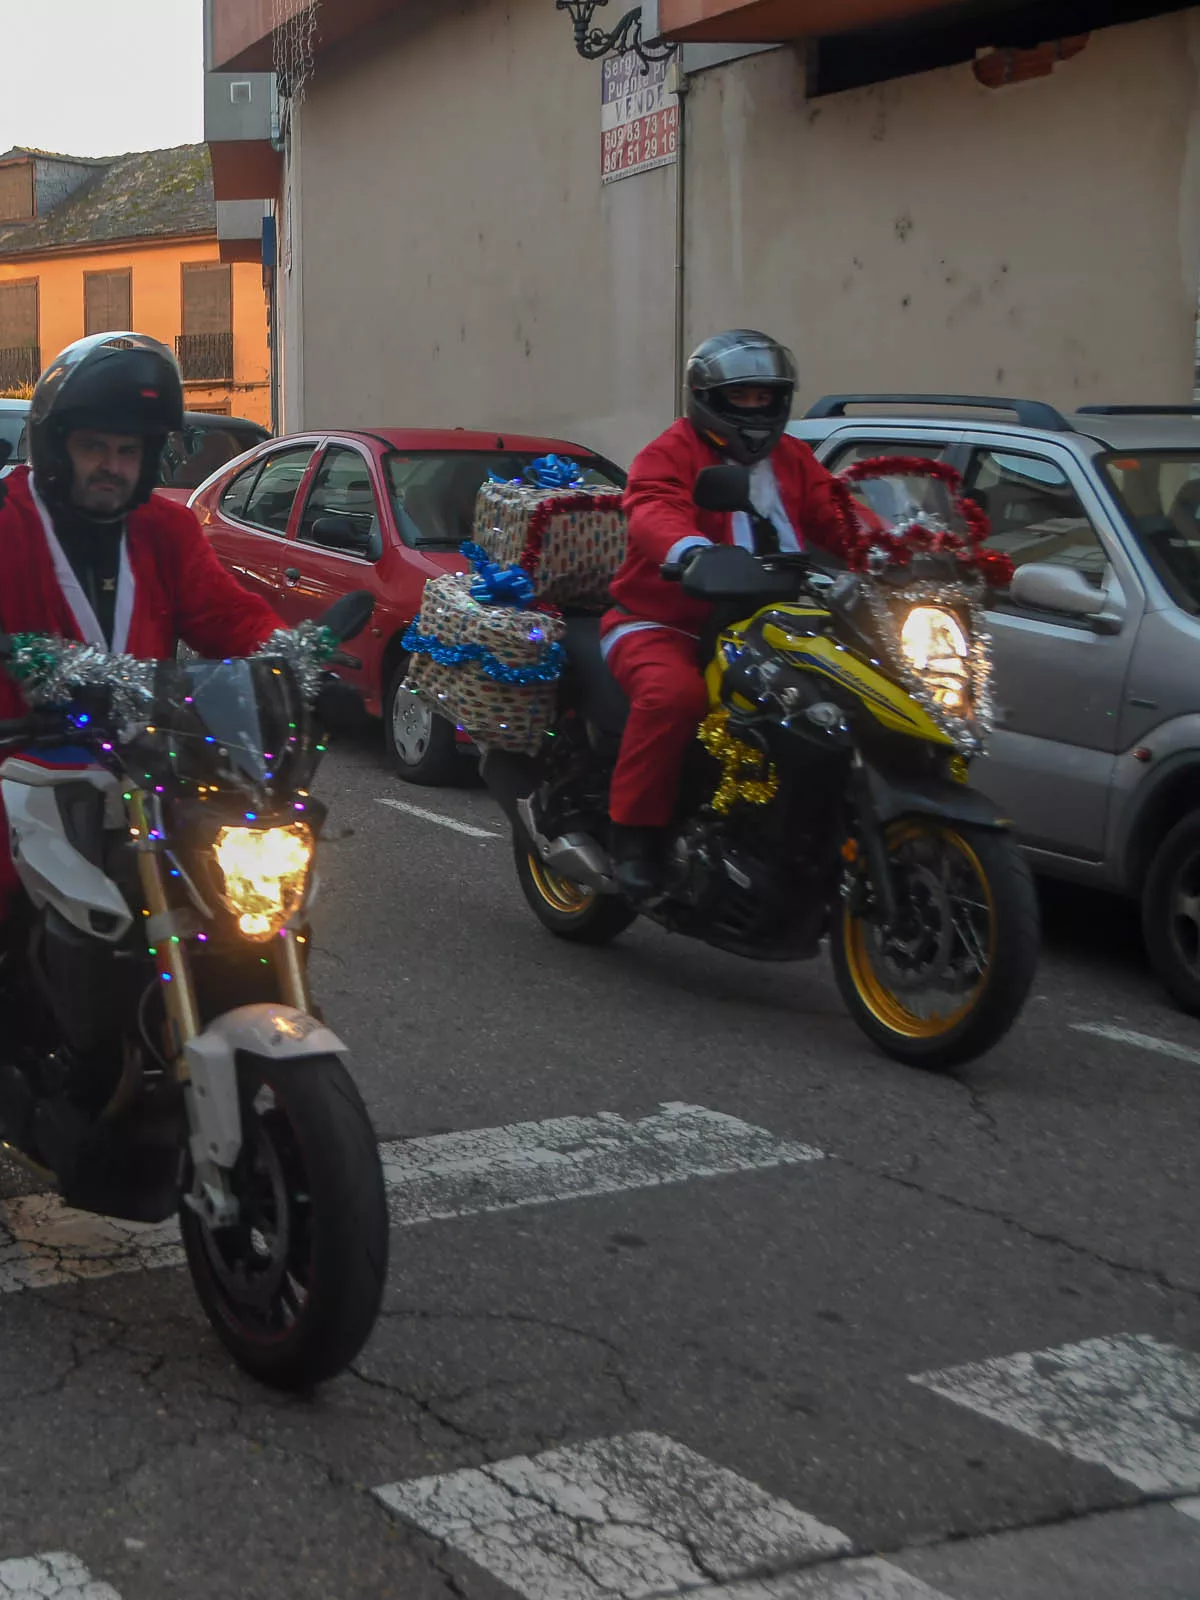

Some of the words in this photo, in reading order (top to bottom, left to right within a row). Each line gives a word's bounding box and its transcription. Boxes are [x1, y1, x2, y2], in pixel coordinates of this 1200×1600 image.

[615, 85, 664, 121] VENDE
[605, 128, 624, 151] 609
[627, 121, 640, 142] 83
[645, 115, 657, 136] 73
[662, 109, 675, 129] 14
[604, 149, 623, 173] 987
[627, 144, 640, 165] 51
[645, 137, 657, 159] 29
[662, 132, 675, 153] 16
